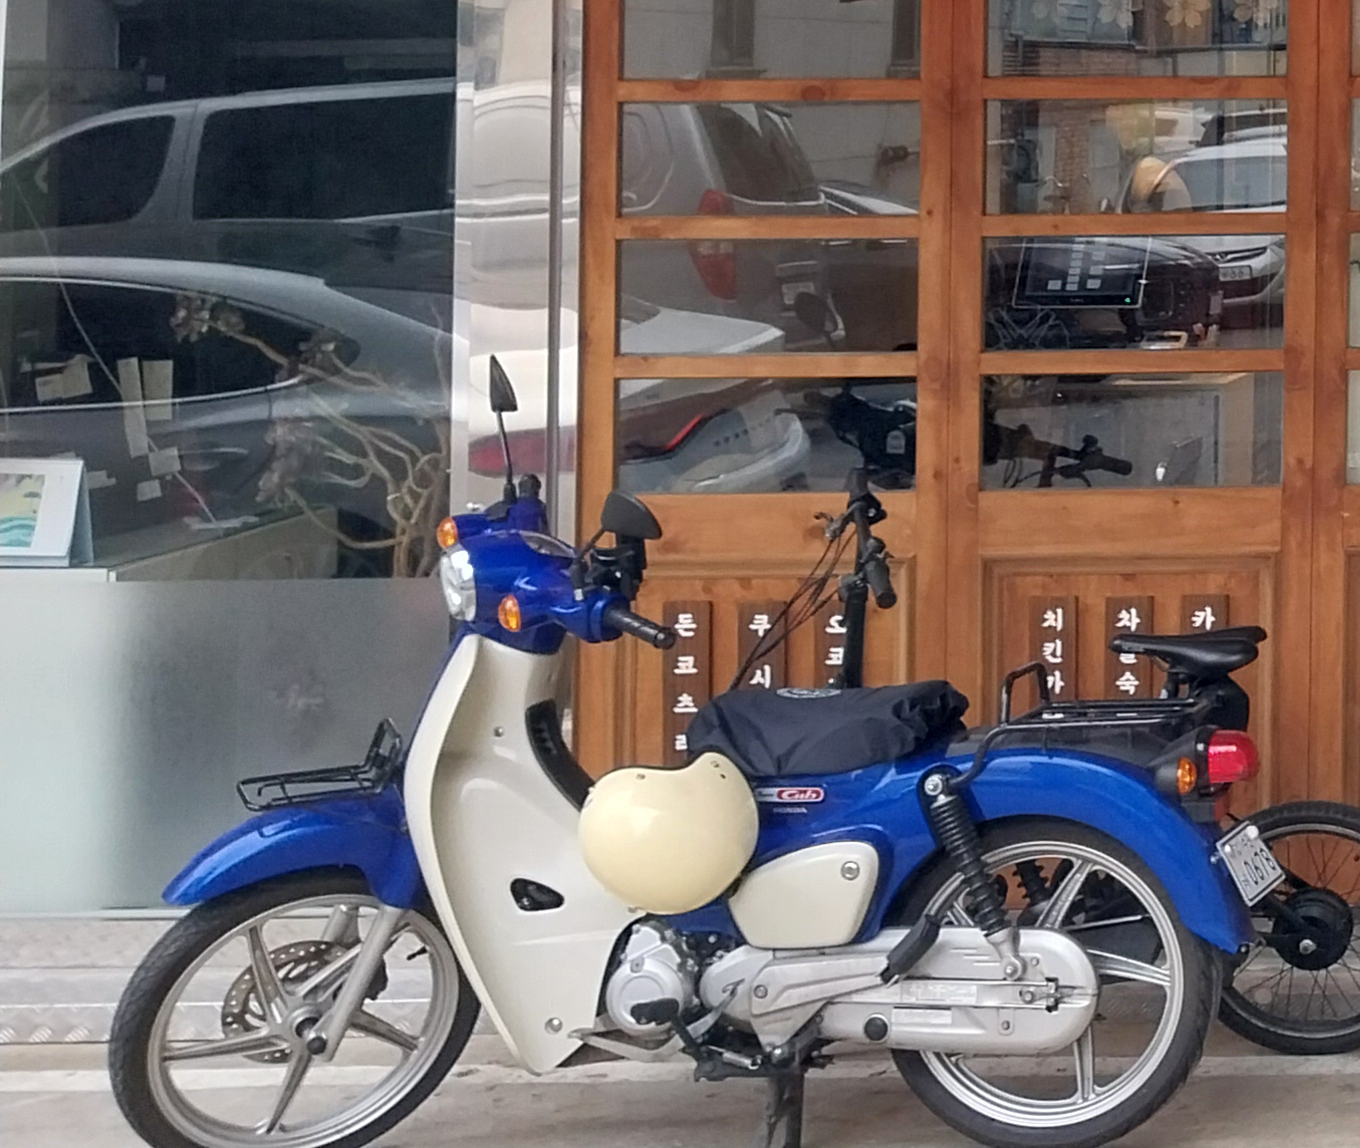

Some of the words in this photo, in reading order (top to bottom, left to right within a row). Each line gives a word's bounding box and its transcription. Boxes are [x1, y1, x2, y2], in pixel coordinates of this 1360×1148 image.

[824, 614, 847, 685] 오코
[1041, 607, 1065, 720] 치킨가
[1247, 848, 1277, 888] 0678
